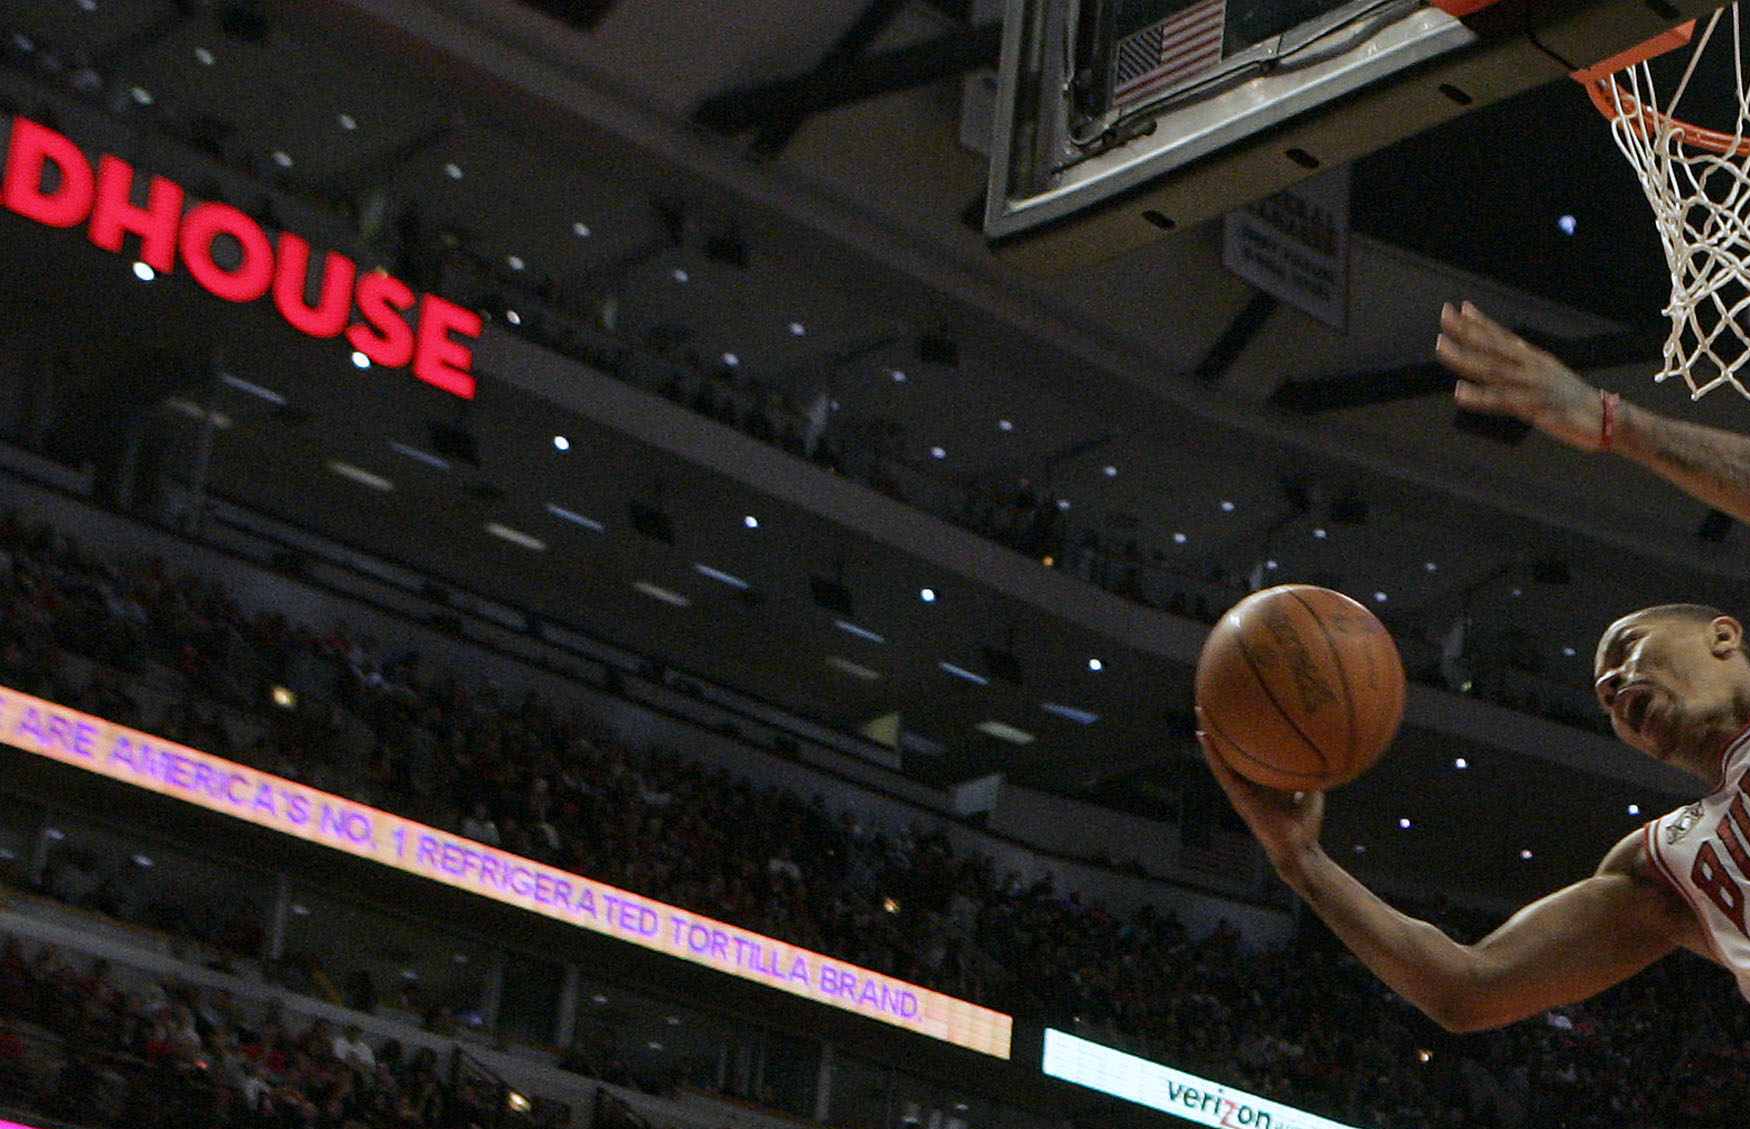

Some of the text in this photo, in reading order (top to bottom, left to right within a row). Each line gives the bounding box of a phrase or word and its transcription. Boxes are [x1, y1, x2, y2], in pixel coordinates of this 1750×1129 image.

[3, 114, 483, 401] DHOUSE
[16, 706, 925, 1023] ARE AMERICA'S NO. 1 REFRIGERATED TORTILLA BRAND.
